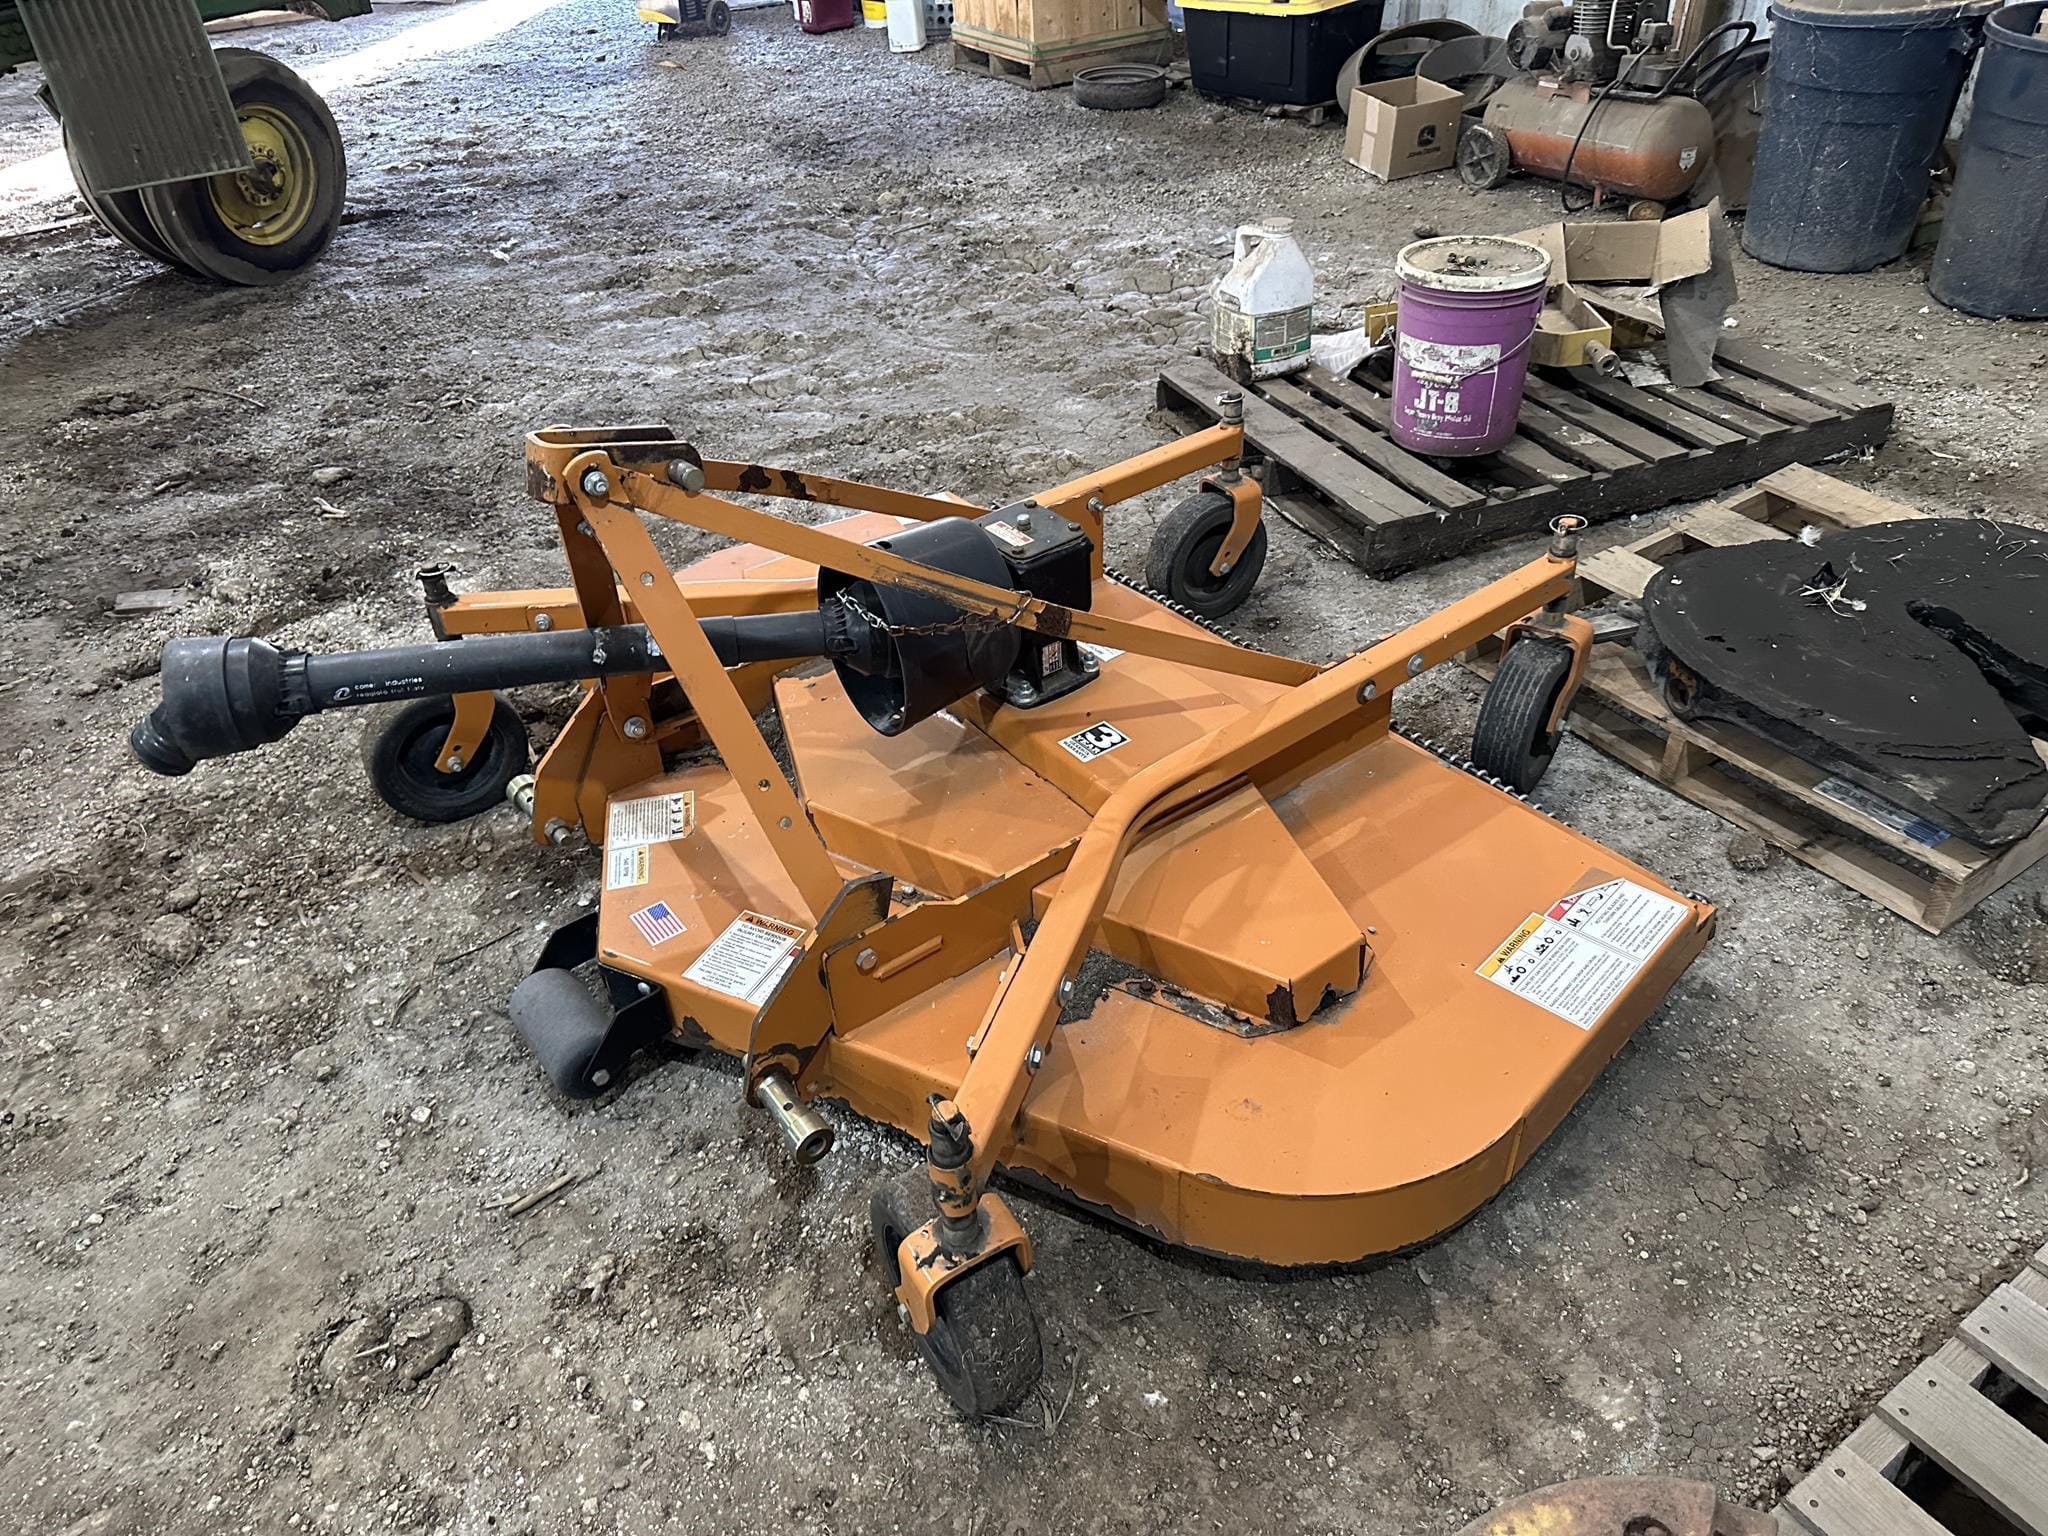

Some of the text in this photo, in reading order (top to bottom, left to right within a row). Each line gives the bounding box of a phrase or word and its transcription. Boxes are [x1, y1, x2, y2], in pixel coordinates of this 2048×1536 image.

[1075, 734, 1101, 753] YEAR
[1084, 726, 1122, 749] 3
[754, 918, 795, 936] WARNING
[1500, 928, 1531, 957] WARNING
